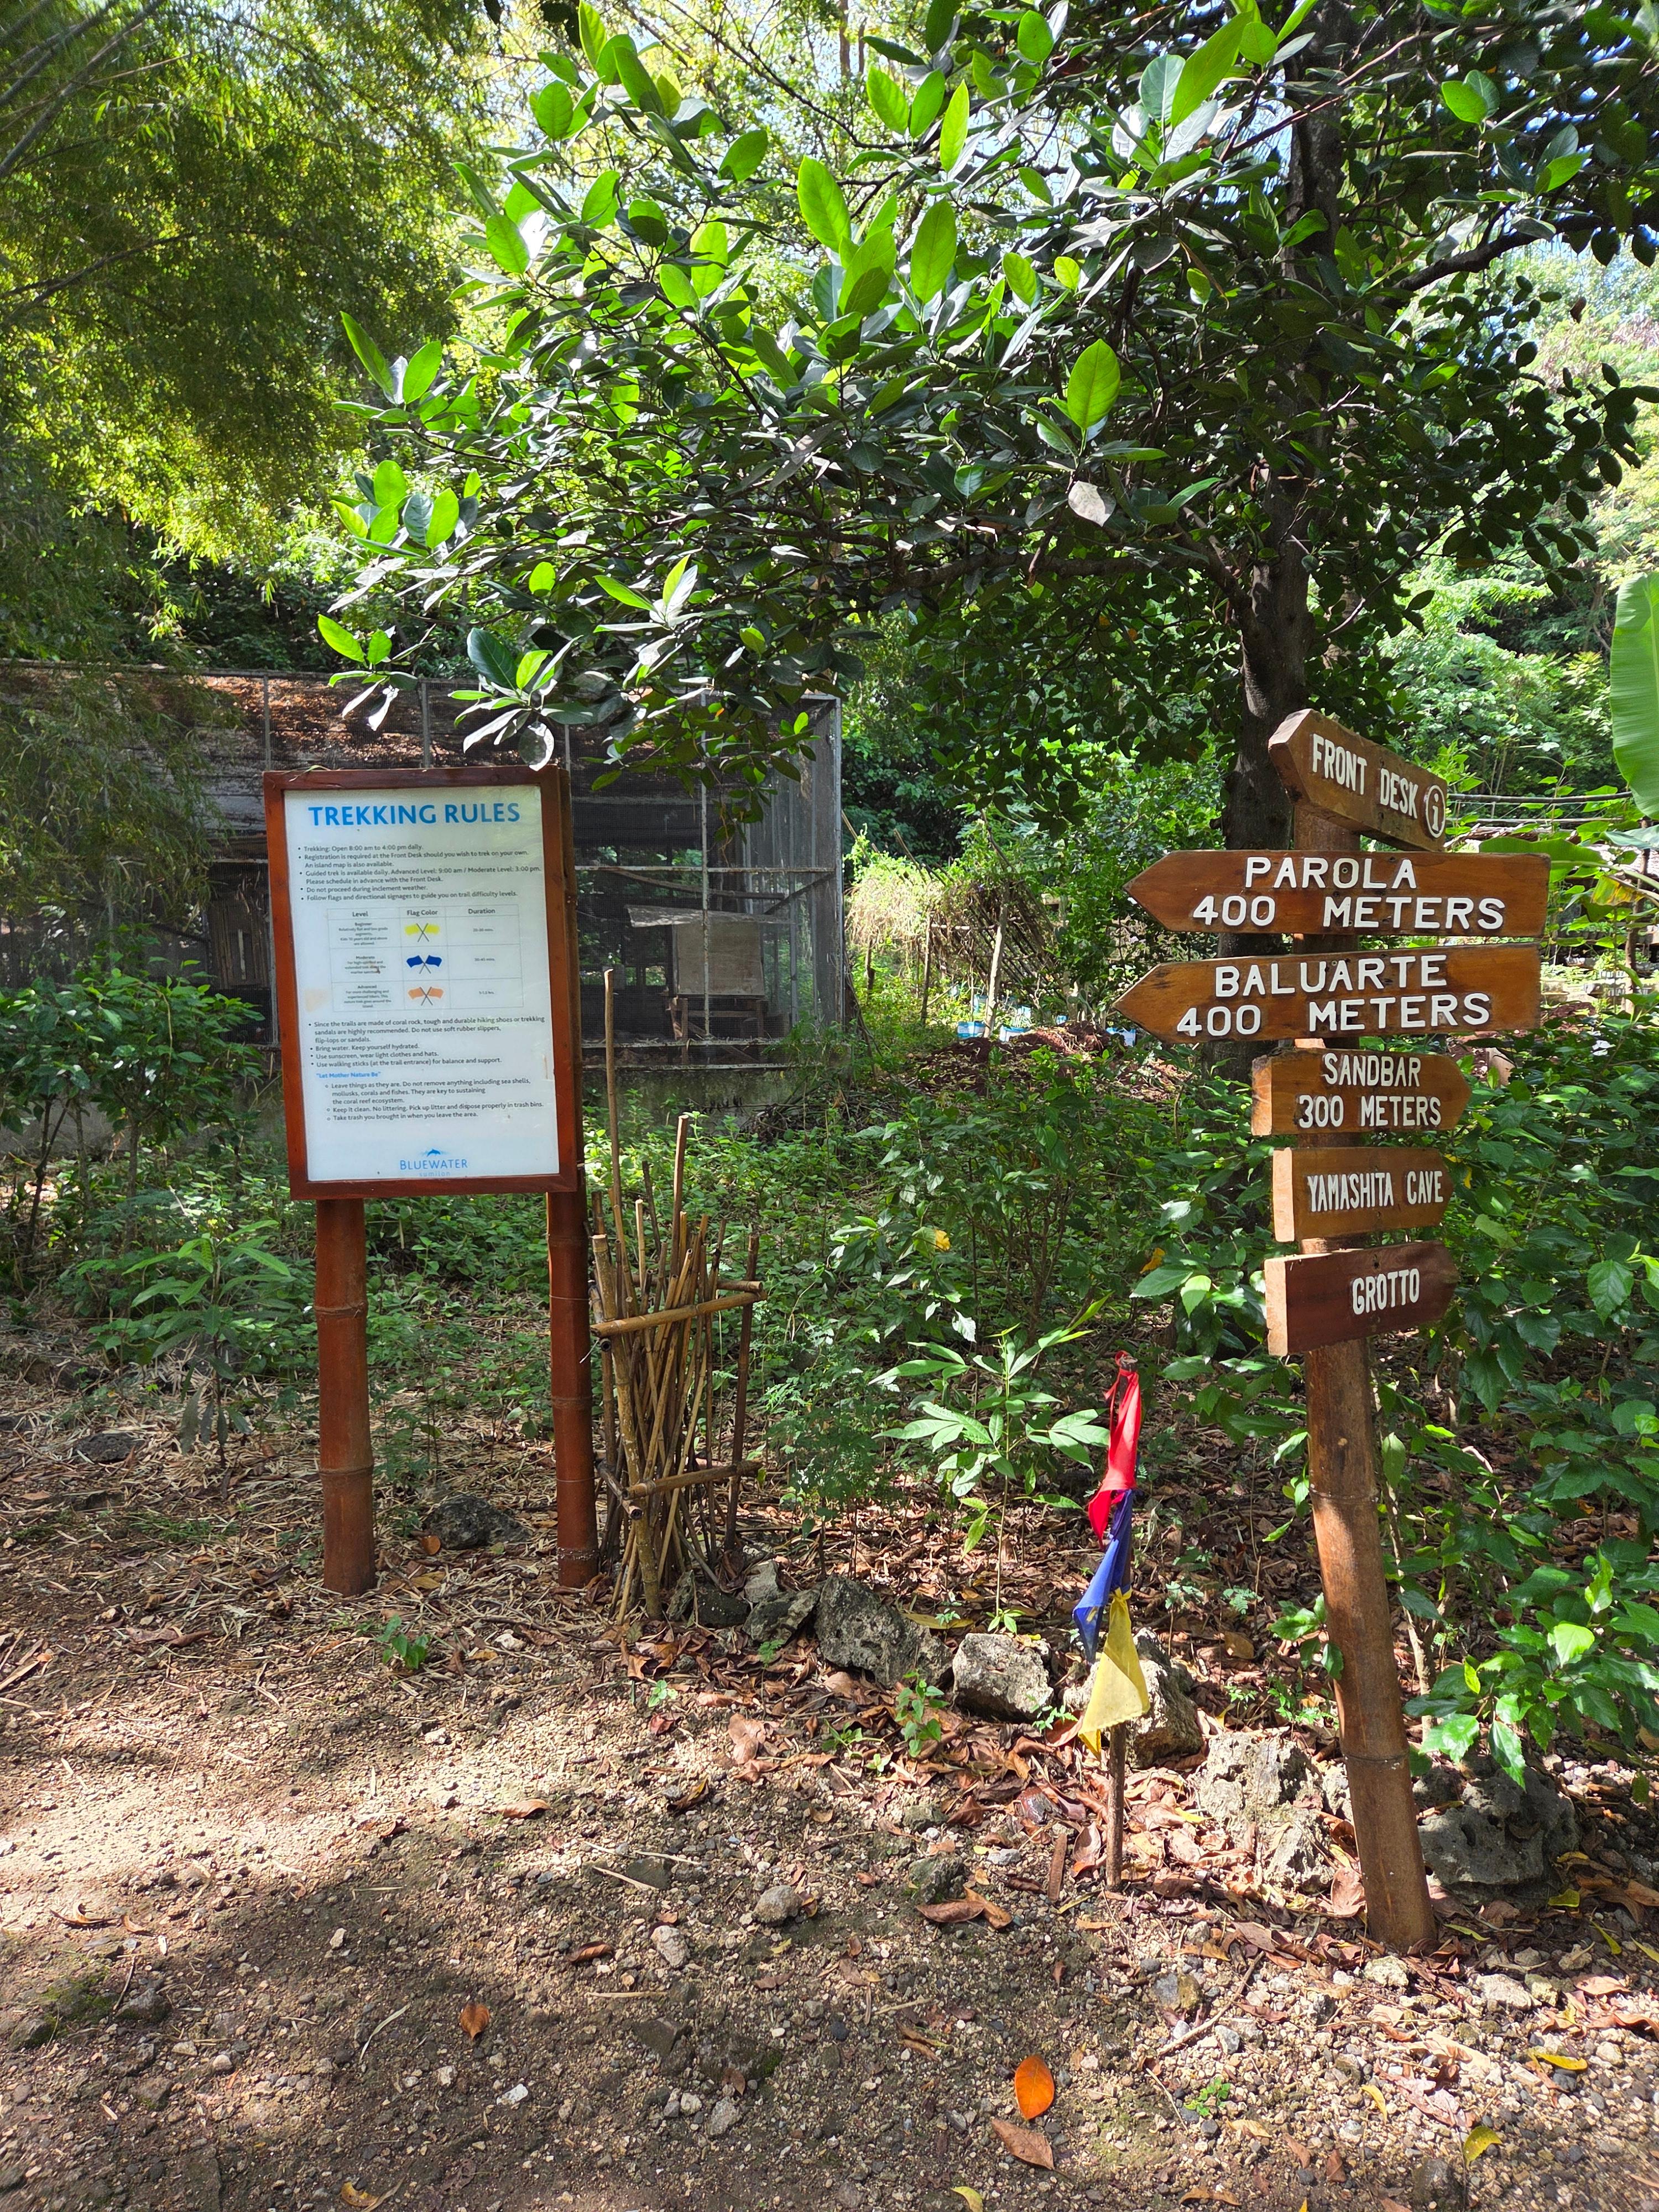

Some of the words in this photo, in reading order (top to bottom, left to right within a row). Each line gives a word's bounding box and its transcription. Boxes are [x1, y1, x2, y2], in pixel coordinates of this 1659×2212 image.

[1312, 733, 1368, 795] FRONT
[1380, 768, 1418, 819] DESK
[307, 805, 436, 826] TREKKING
[445, 802, 520, 823] RULES
[1245, 857, 1417, 889] PAROLA
[328, 893, 342, 901] flags
[1193, 895, 1276, 926] 400
[1323, 896, 1505, 930] METERS
[1215, 954, 1447, 997] BALUARTE
[1177, 1004, 1261, 1036] 400
[1309, 993, 1490, 1032] METERS
[1322, 1053, 1421, 1087] SANDBAR
[1298, 1095, 1344, 1128] 300
[1361, 1095, 1441, 1127] METERS
[400, 1159, 468, 1170] BLUEWATER
[1307, 1172, 1394, 1212] YAMASHITA
[1407, 1171, 1443, 1204] CAVE
[1353, 1268, 1420, 1315] GROTTO
